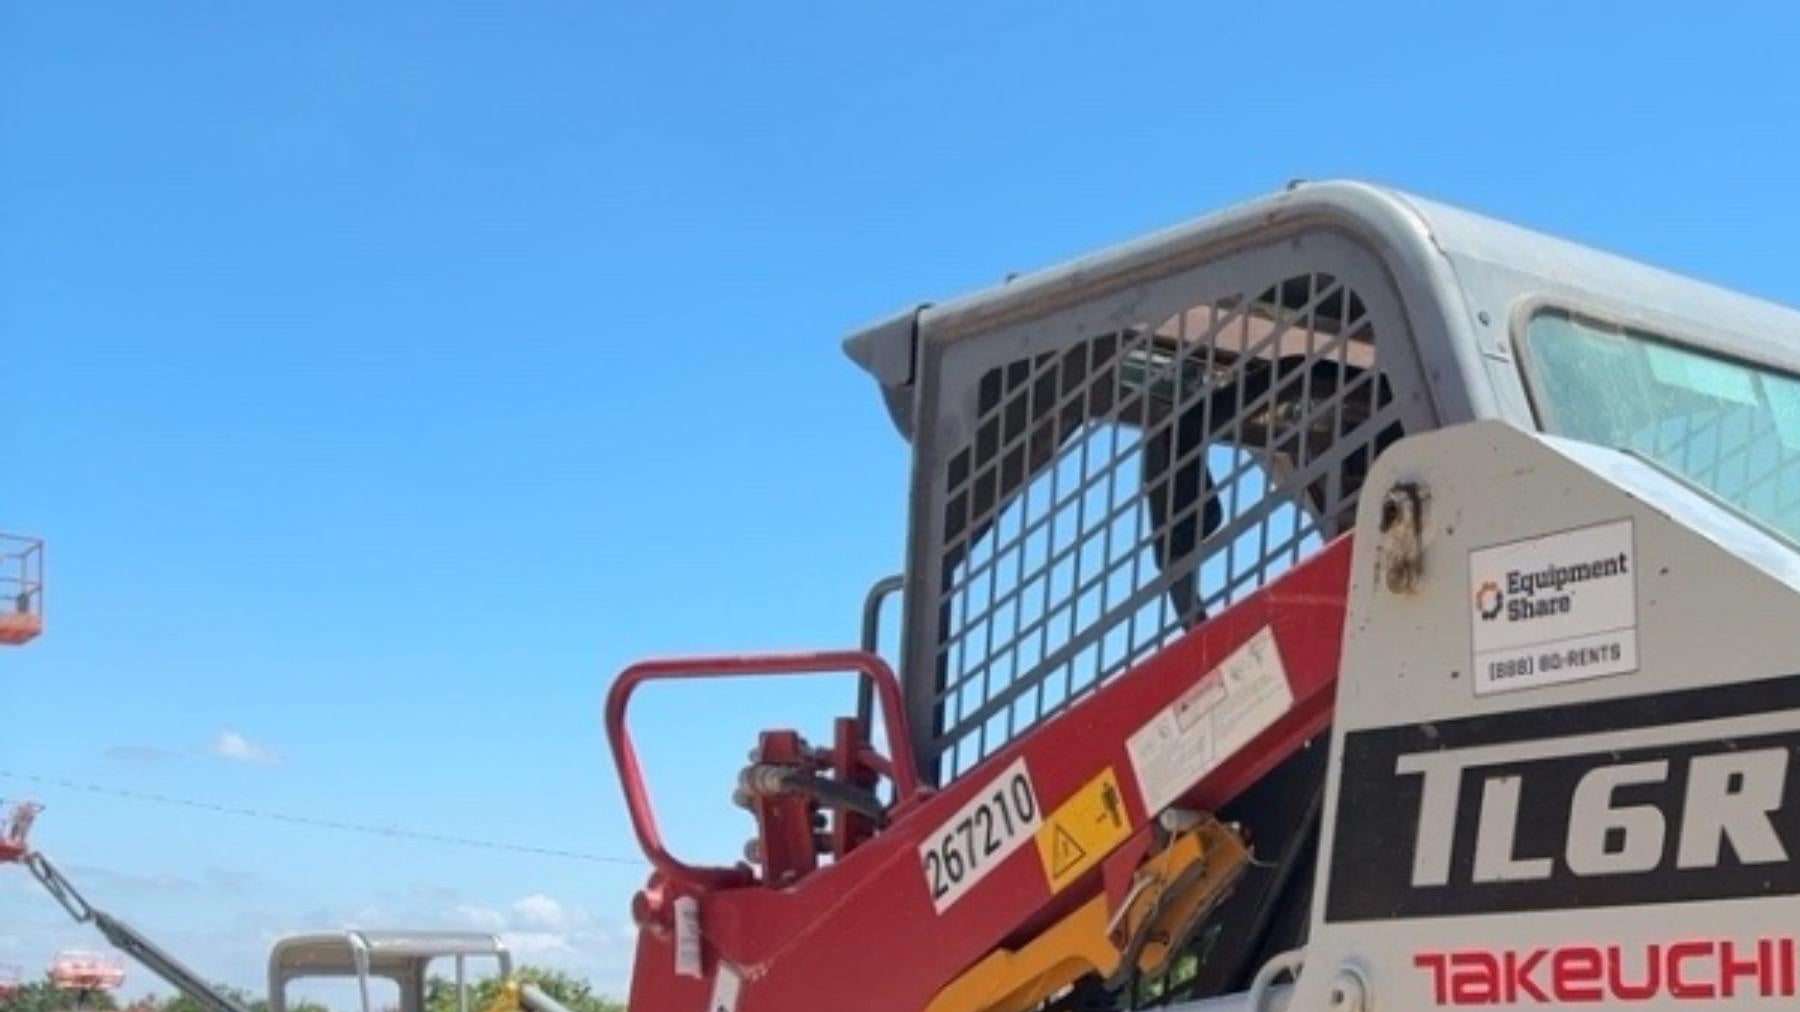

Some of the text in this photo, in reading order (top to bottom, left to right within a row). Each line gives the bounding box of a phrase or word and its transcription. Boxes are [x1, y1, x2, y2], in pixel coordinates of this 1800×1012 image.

[1506, 552, 1627, 595] Equipment
[1507, 595, 1570, 622] Share
[925, 774, 1034, 898] 267210
